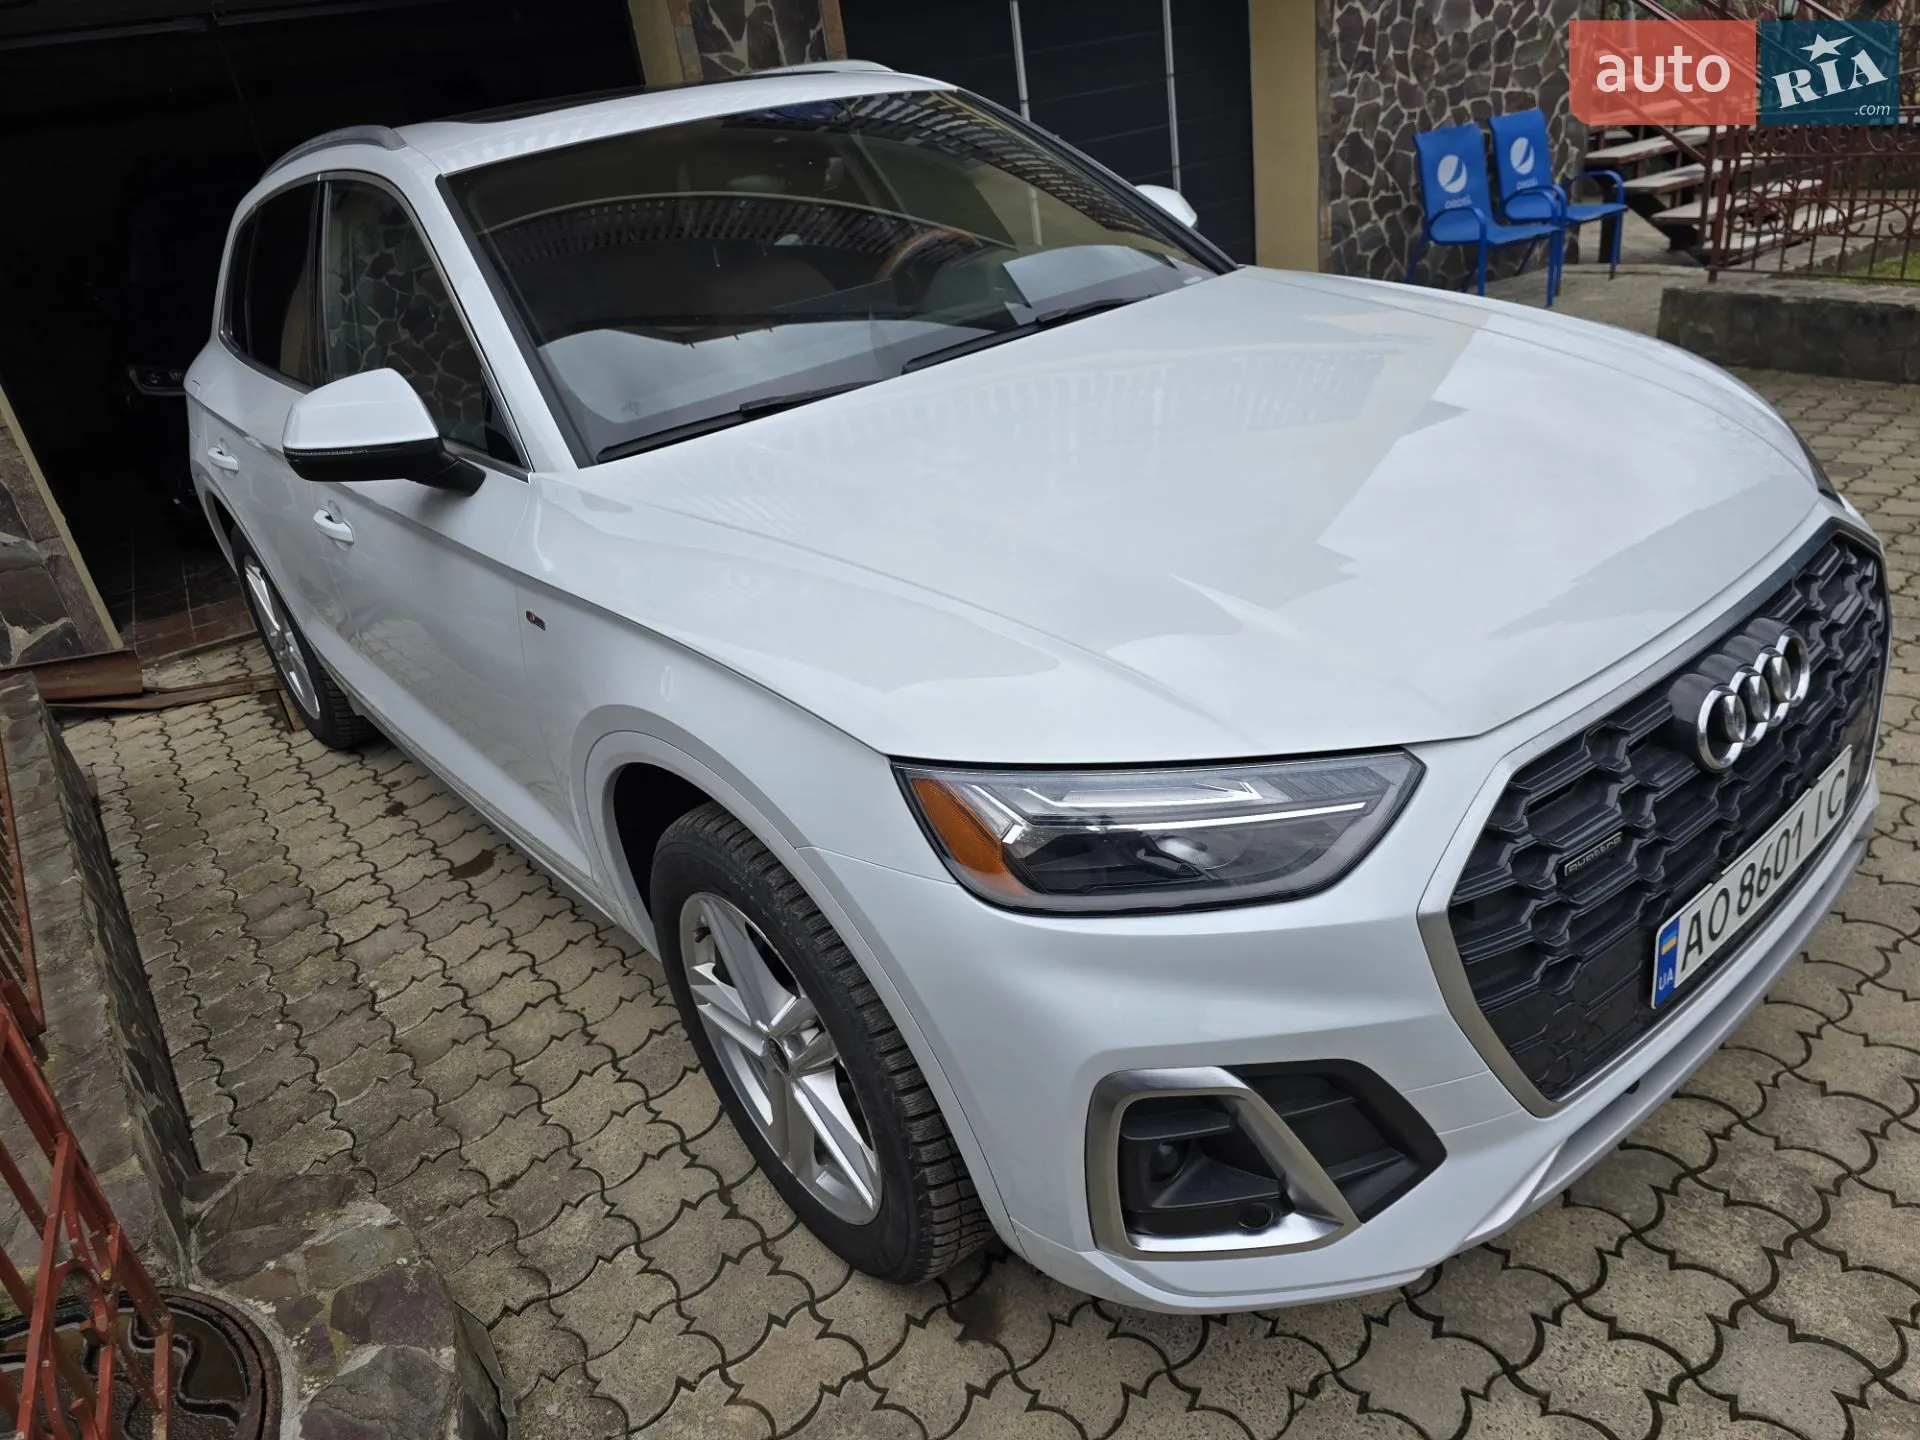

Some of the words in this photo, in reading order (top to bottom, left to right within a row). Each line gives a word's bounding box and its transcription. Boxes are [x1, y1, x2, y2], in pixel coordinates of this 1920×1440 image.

[1681, 887, 1730, 972] AO
[1737, 809, 1805, 916] 8601
[1813, 768, 1846, 838] IC
[1658, 967, 1674, 990] UA
